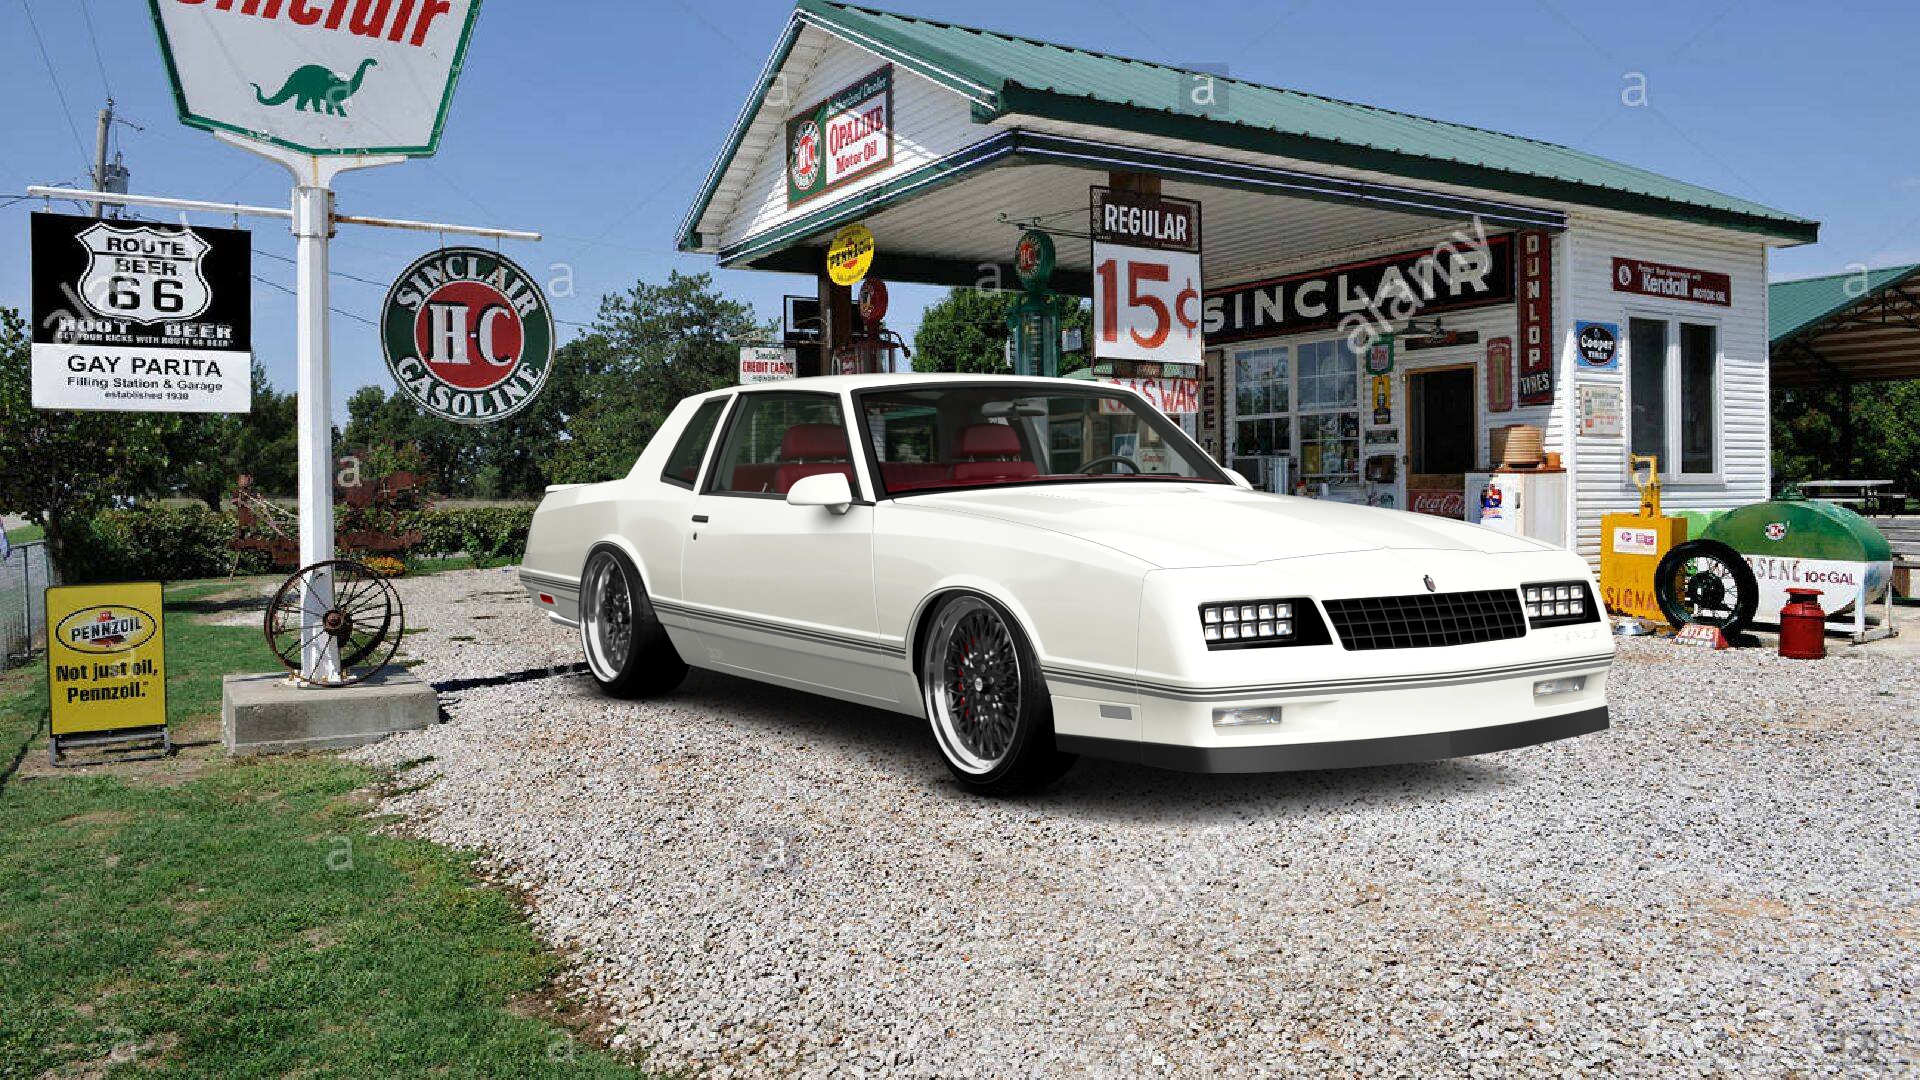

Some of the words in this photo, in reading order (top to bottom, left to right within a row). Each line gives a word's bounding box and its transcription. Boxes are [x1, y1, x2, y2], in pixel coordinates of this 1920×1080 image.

[177, 0, 450, 47] clair
[830, 105, 883, 157] OPALINE
[836, 151, 863, 174] Motor
[864, 140, 878, 161] Oil
[1104, 203, 1187, 242] REGULAR
[106, 238, 186, 255] ROUTE
[114, 257, 177, 276] BEER
[108, 275, 184, 312] 66
[396, 255, 540, 318] SINCLAIR
[1202, 250, 1490, 334] SINCLAIR
[1643, 272, 1688, 297] Kendall
[1096, 258, 1199, 349] 15¢
[1526, 234, 1542, 368] DUNLOP
[164, 321, 233, 340] BEER
[1581, 334, 1614, 353] Cooper
[67, 354, 121, 375] GAY
[131, 356, 223, 378] PARITA
[742, 361, 768, 373] CREDIT
[770, 362, 794, 375] CARDS
[67, 376, 109, 391] Filling
[113, 377, 159, 390] Station
[163, 379, 174, 390] &
[177, 380, 223, 394] Garage
[104, 390, 163, 400] established
[396, 356, 542, 417] GASOLINE
[1158, 377, 1199, 413] WAR
[1520, 371, 1551, 396] TIRES
[1828, 571, 1855, 585] GAL
[71, 617, 143, 642] PENNZOIL
[56, 664, 88, 682] Not
[92, 662, 128, 682] just
[132, 659, 158, 677] oil,
[67, 682, 147, 703] Pennzoil.
